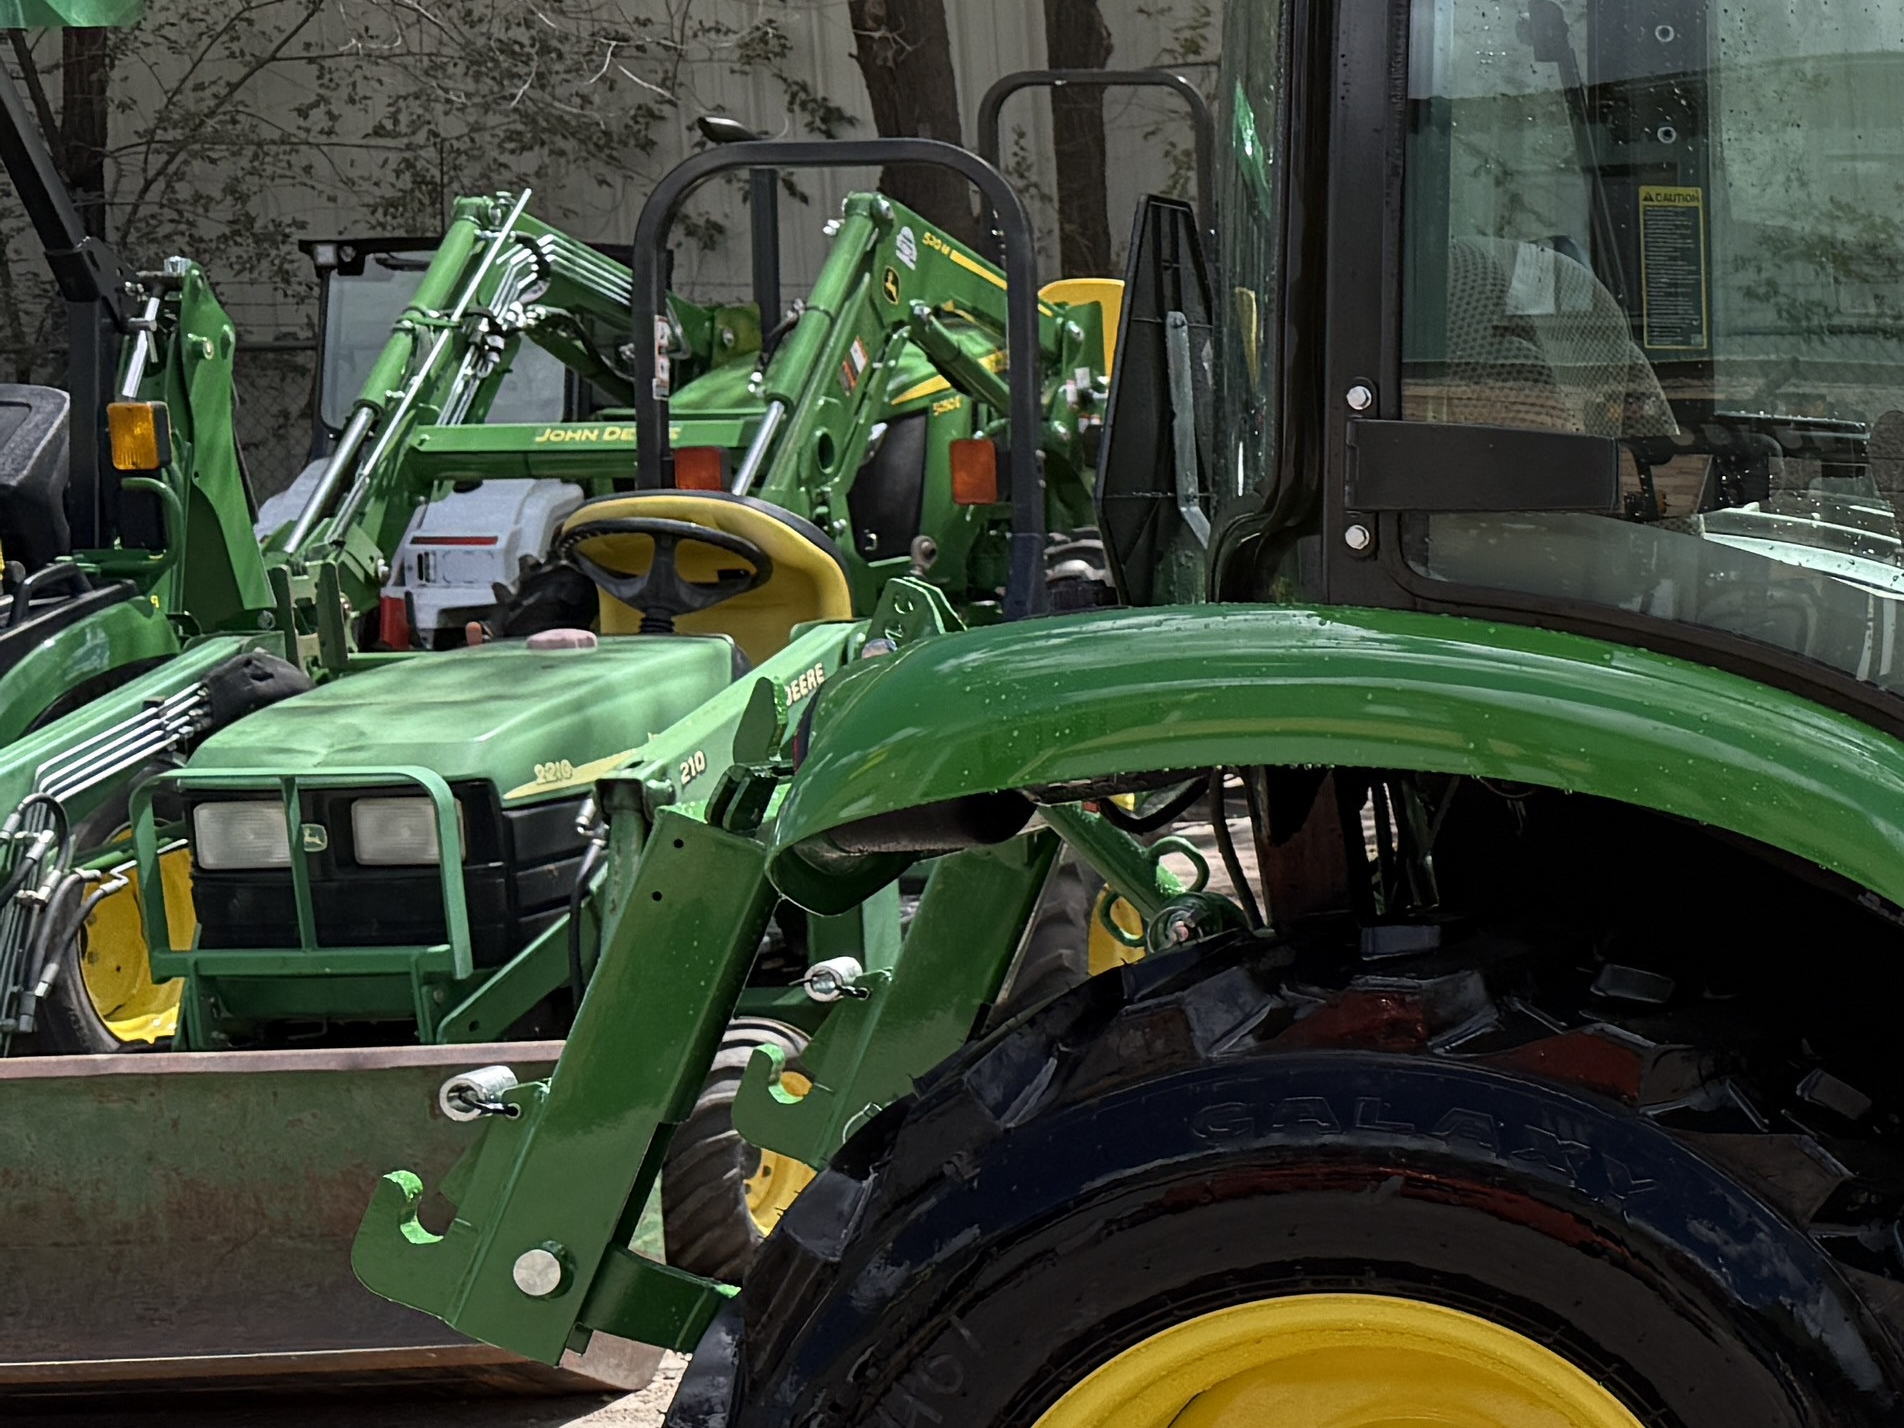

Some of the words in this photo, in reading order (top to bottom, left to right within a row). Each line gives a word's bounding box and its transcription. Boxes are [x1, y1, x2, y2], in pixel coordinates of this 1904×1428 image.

[1656, 192, 1700, 203] CAUTION
[534, 427, 599, 443] JOHN
[602, 425, 683, 442] DEE
[533, 758, 574, 785] 2210
[679, 750, 707, 785] 210
